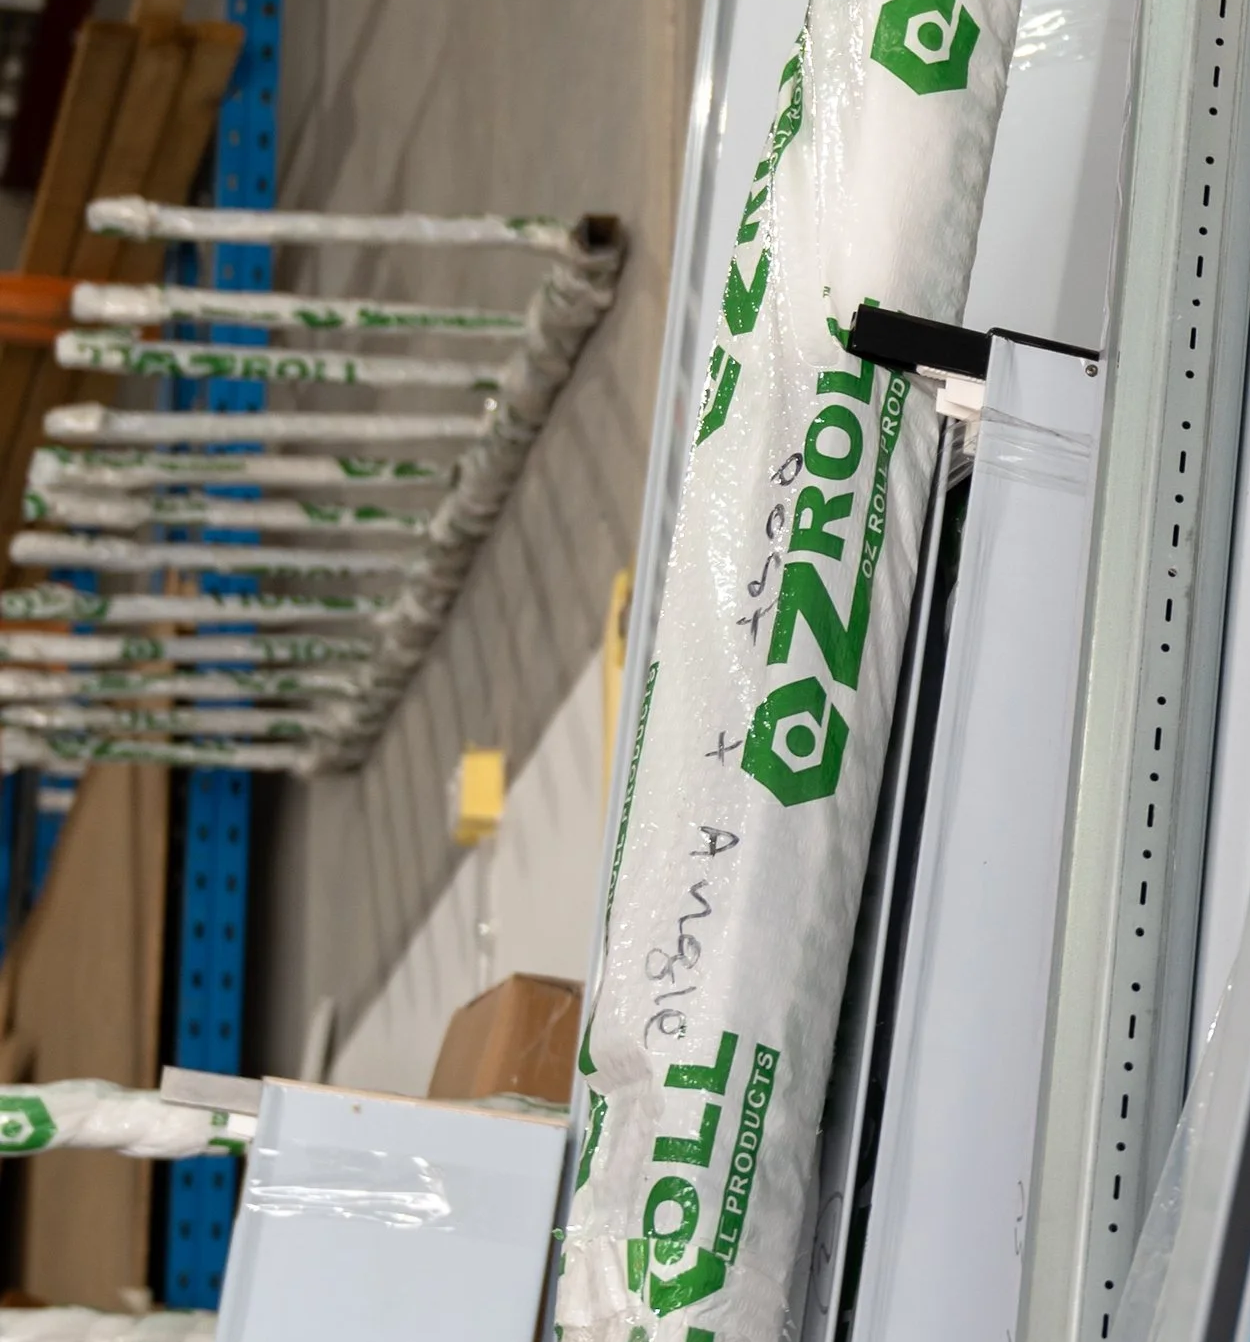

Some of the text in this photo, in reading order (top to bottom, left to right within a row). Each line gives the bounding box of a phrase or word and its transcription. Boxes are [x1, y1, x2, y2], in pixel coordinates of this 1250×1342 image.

[861, 377, 905, 579] OZ ROLL PROD
[726, 1052, 773, 1215] PRODUCTS
